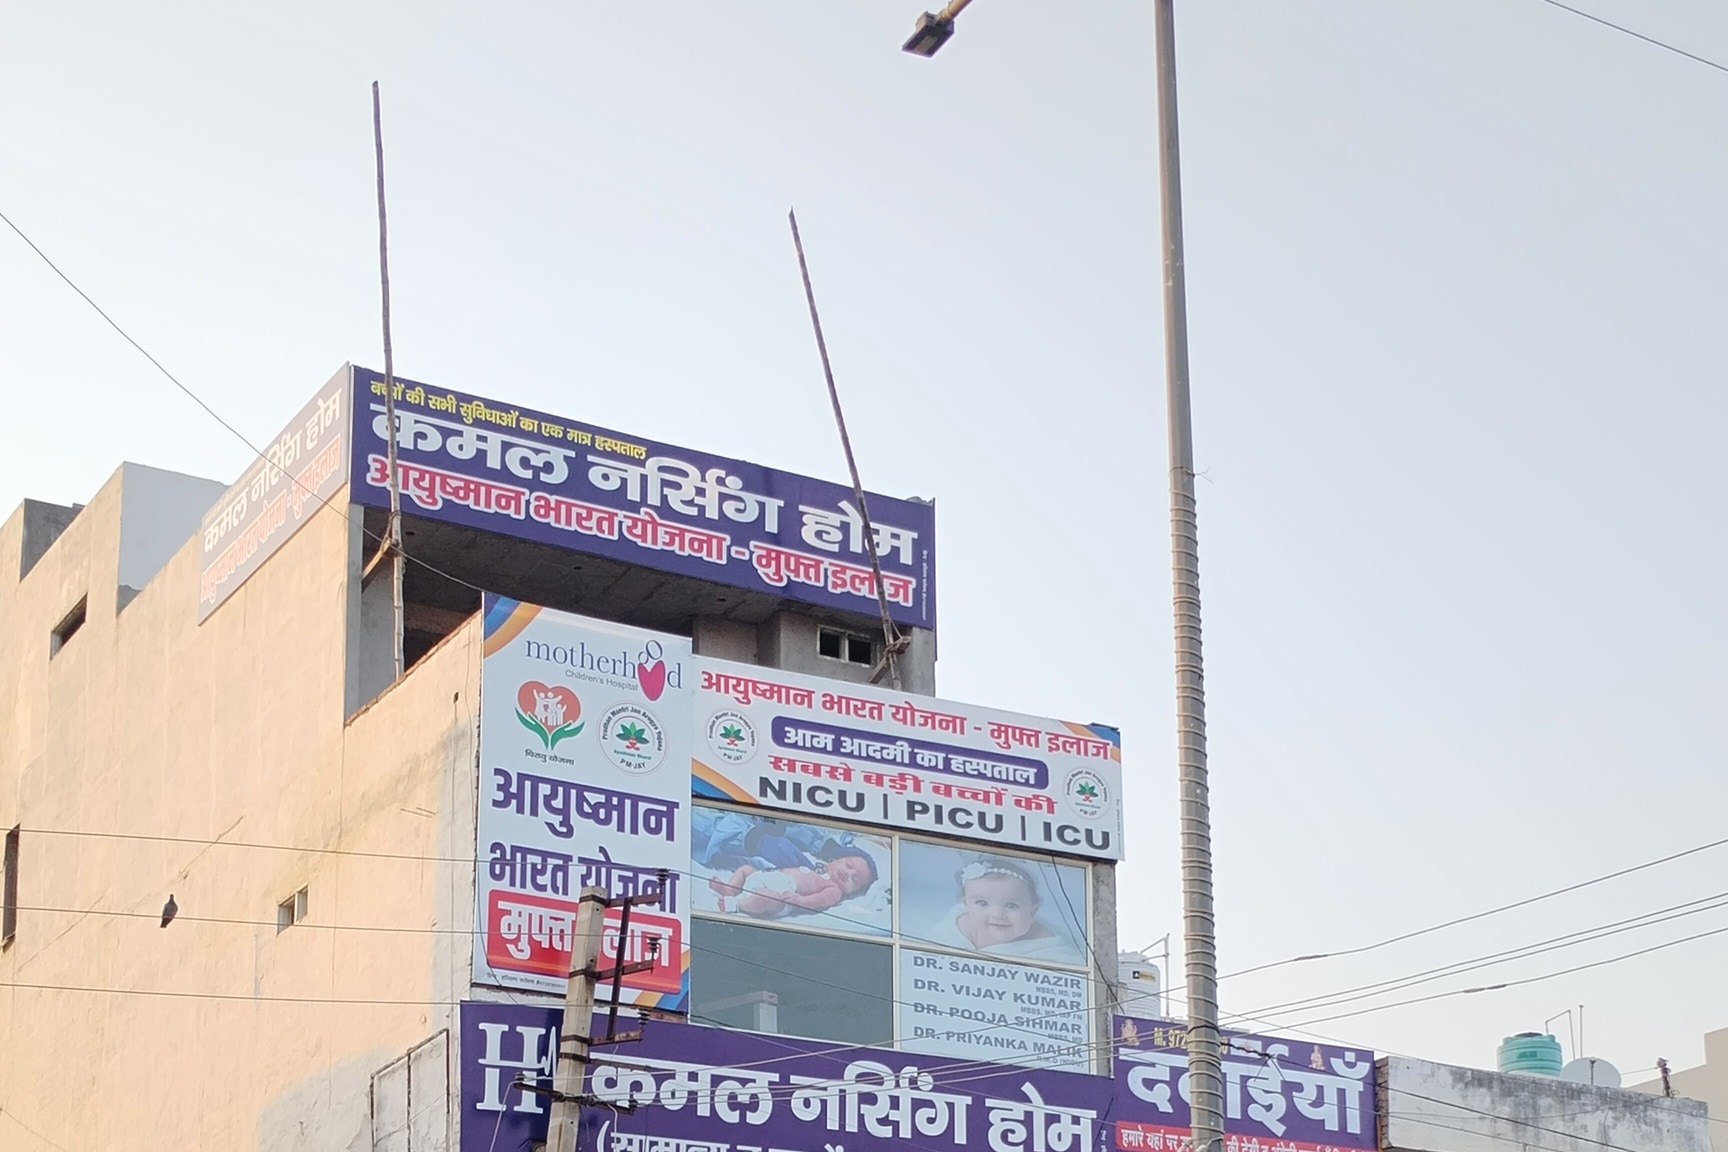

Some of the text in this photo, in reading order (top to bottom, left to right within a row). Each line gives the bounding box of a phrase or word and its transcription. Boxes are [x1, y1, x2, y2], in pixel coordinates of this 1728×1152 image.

[406, 388, 647, 460] की सभी सुविधाओं का एक मात्र हस्पताल
[369, 402, 919, 566] कमल नर्सिंग होम
[203, 486, 250, 552] कमल
[368, 455, 527, 518] आयुष्मान
[532, 493, 618, 538] भारत
[623, 508, 729, 563] योजना
[752, 542, 824, 585] मुफ्त
[827, 561, 915, 606] इलाज
[606, 679, 638, 692] Hospital
[700, 670, 1112, 760] आयुष्मान भारत योजना मुफ्त इलाज
[768, 754, 1058, 815] सबसे बच्चों की
[783, 726, 836, 752] आम
[840, 735, 912, 765] आदमी
[913, 748, 946, 770] का
[948, 753, 1037, 785] हस्पताल
[491, 767, 680, 843] आयुष्मान
[758, 776, 866, 814] NICU
[906, 799, 1004, 834] PICU
[1042, 821, 1111, 852] ICU
[488, 841, 574, 897] भारत
[497, 900, 576, 961] मुफ्त
[948, 961, 1082, 990] SANJAY WAZIR
[951, 983, 1082, 1011] VIJAY KUMAR
[945, 1030, 1029, 1052] PRIYANKA
[1032, 1040, 1084, 1059] MALIK
[949, 1006, 1009, 1026] POOJA
[1013, 1015, 1083, 1035] SIHMAR
[589, 1051, 780, 1126] कमल
[789, 1059, 973, 1146] नर्सिंग
[1121, 1125, 1145, 1148] हमारे
